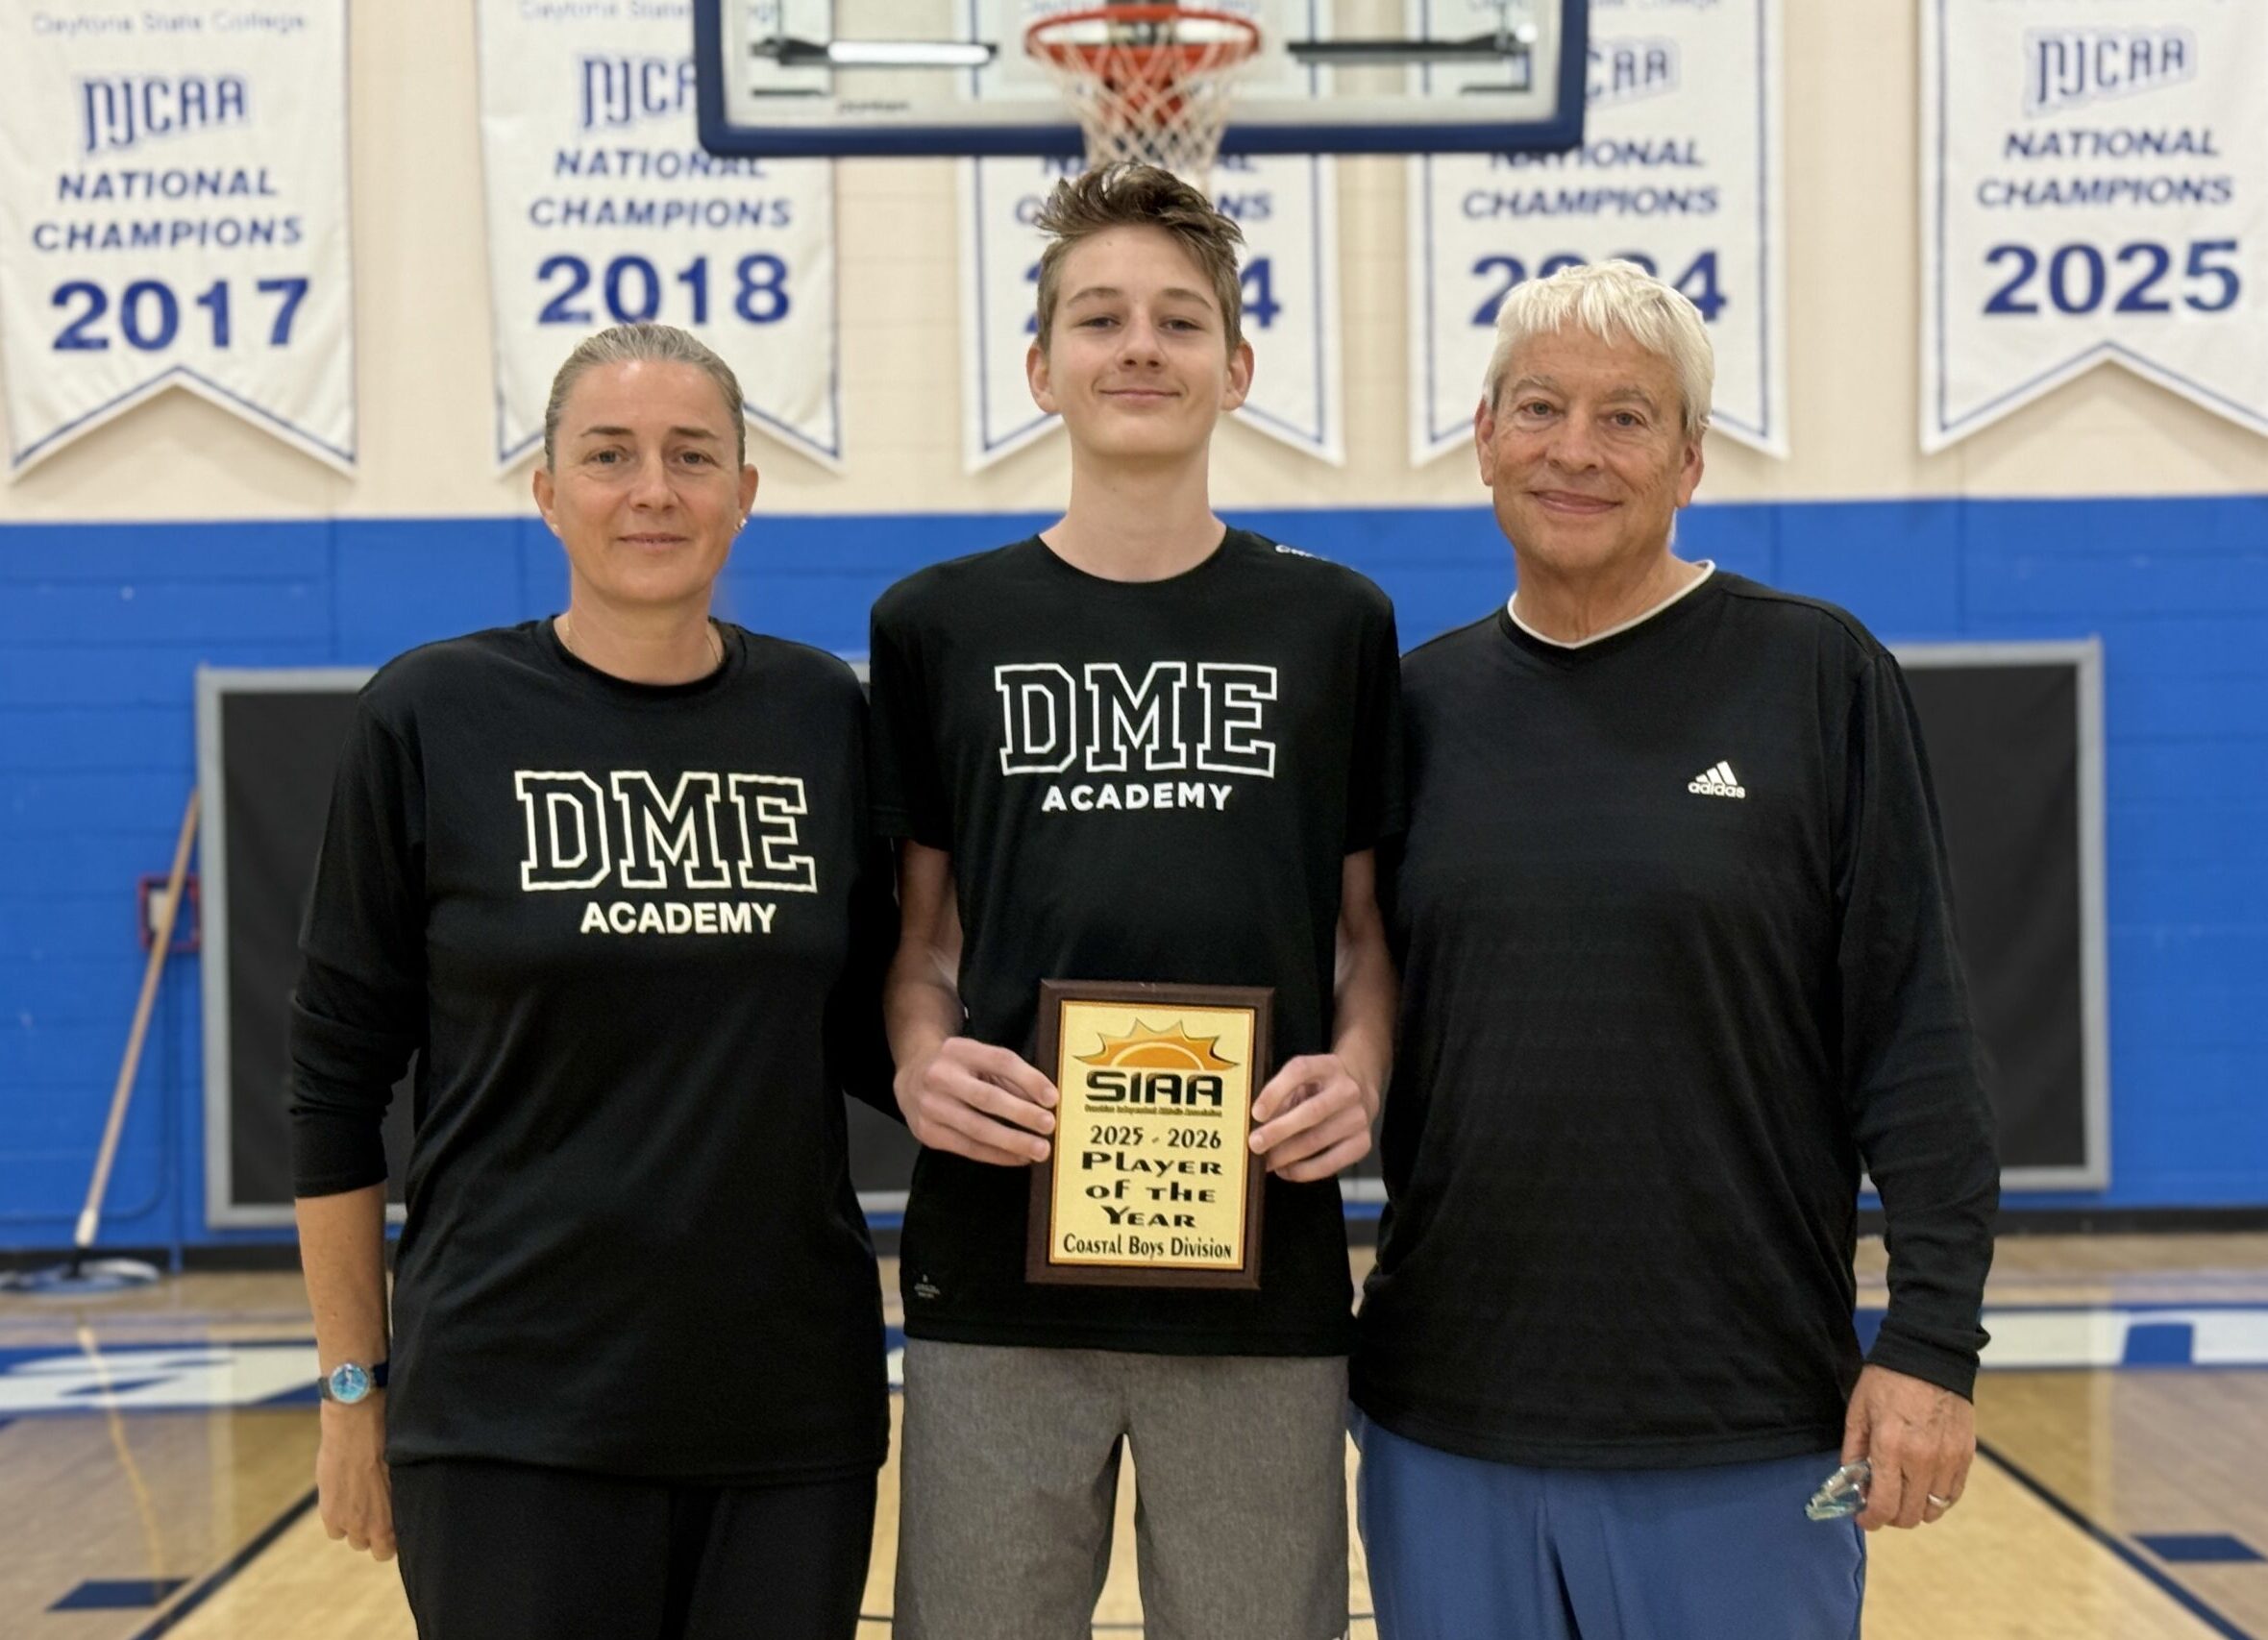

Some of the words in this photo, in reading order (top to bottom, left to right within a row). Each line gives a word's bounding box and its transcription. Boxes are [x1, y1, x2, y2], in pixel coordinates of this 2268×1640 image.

[2037, 37, 2184, 106] NJCAA
[582, 56, 696, 128] NJCA
[83, 77, 245, 152] NJCAA
[2005, 129, 2220, 159] NATIONAL
[554, 148, 766, 180] NATIONAL
[59, 167, 277, 201] NATIONAL
[1977, 176, 2234, 208] CHAMPIONS
[530, 198, 791, 228] CHAMPIONS
[1463, 186, 1719, 219] CHAMPIONS
[33, 216, 302, 251] CHAMPIONS
[537, 254, 790, 325] 2018
[1470, 247, 1728, 327] 24
[1983, 240, 2241, 314] 2025
[52, 277, 309, 352] 2017
[995, 661, 1277, 778] DME
[1041, 781, 1233, 812] ACADEMY
[1688, 780, 1746, 799] adidas
[514, 770, 818, 893] DME
[580, 900, 777, 935] ACADEMY
[1084, 1070, 1223, 1106] SIAA
[1090, 1125, 1144, 1146] 2025
[1168, 1128, 1221, 1149] 2026
[1085, 1179, 1131, 1200] of
[1100, 1205, 1196, 1228] Year
[1063, 1233, 1122, 1256] Coastal
[1128, 1235, 1165, 1261] Boys
[1171, 1236, 1232, 1259] Division
